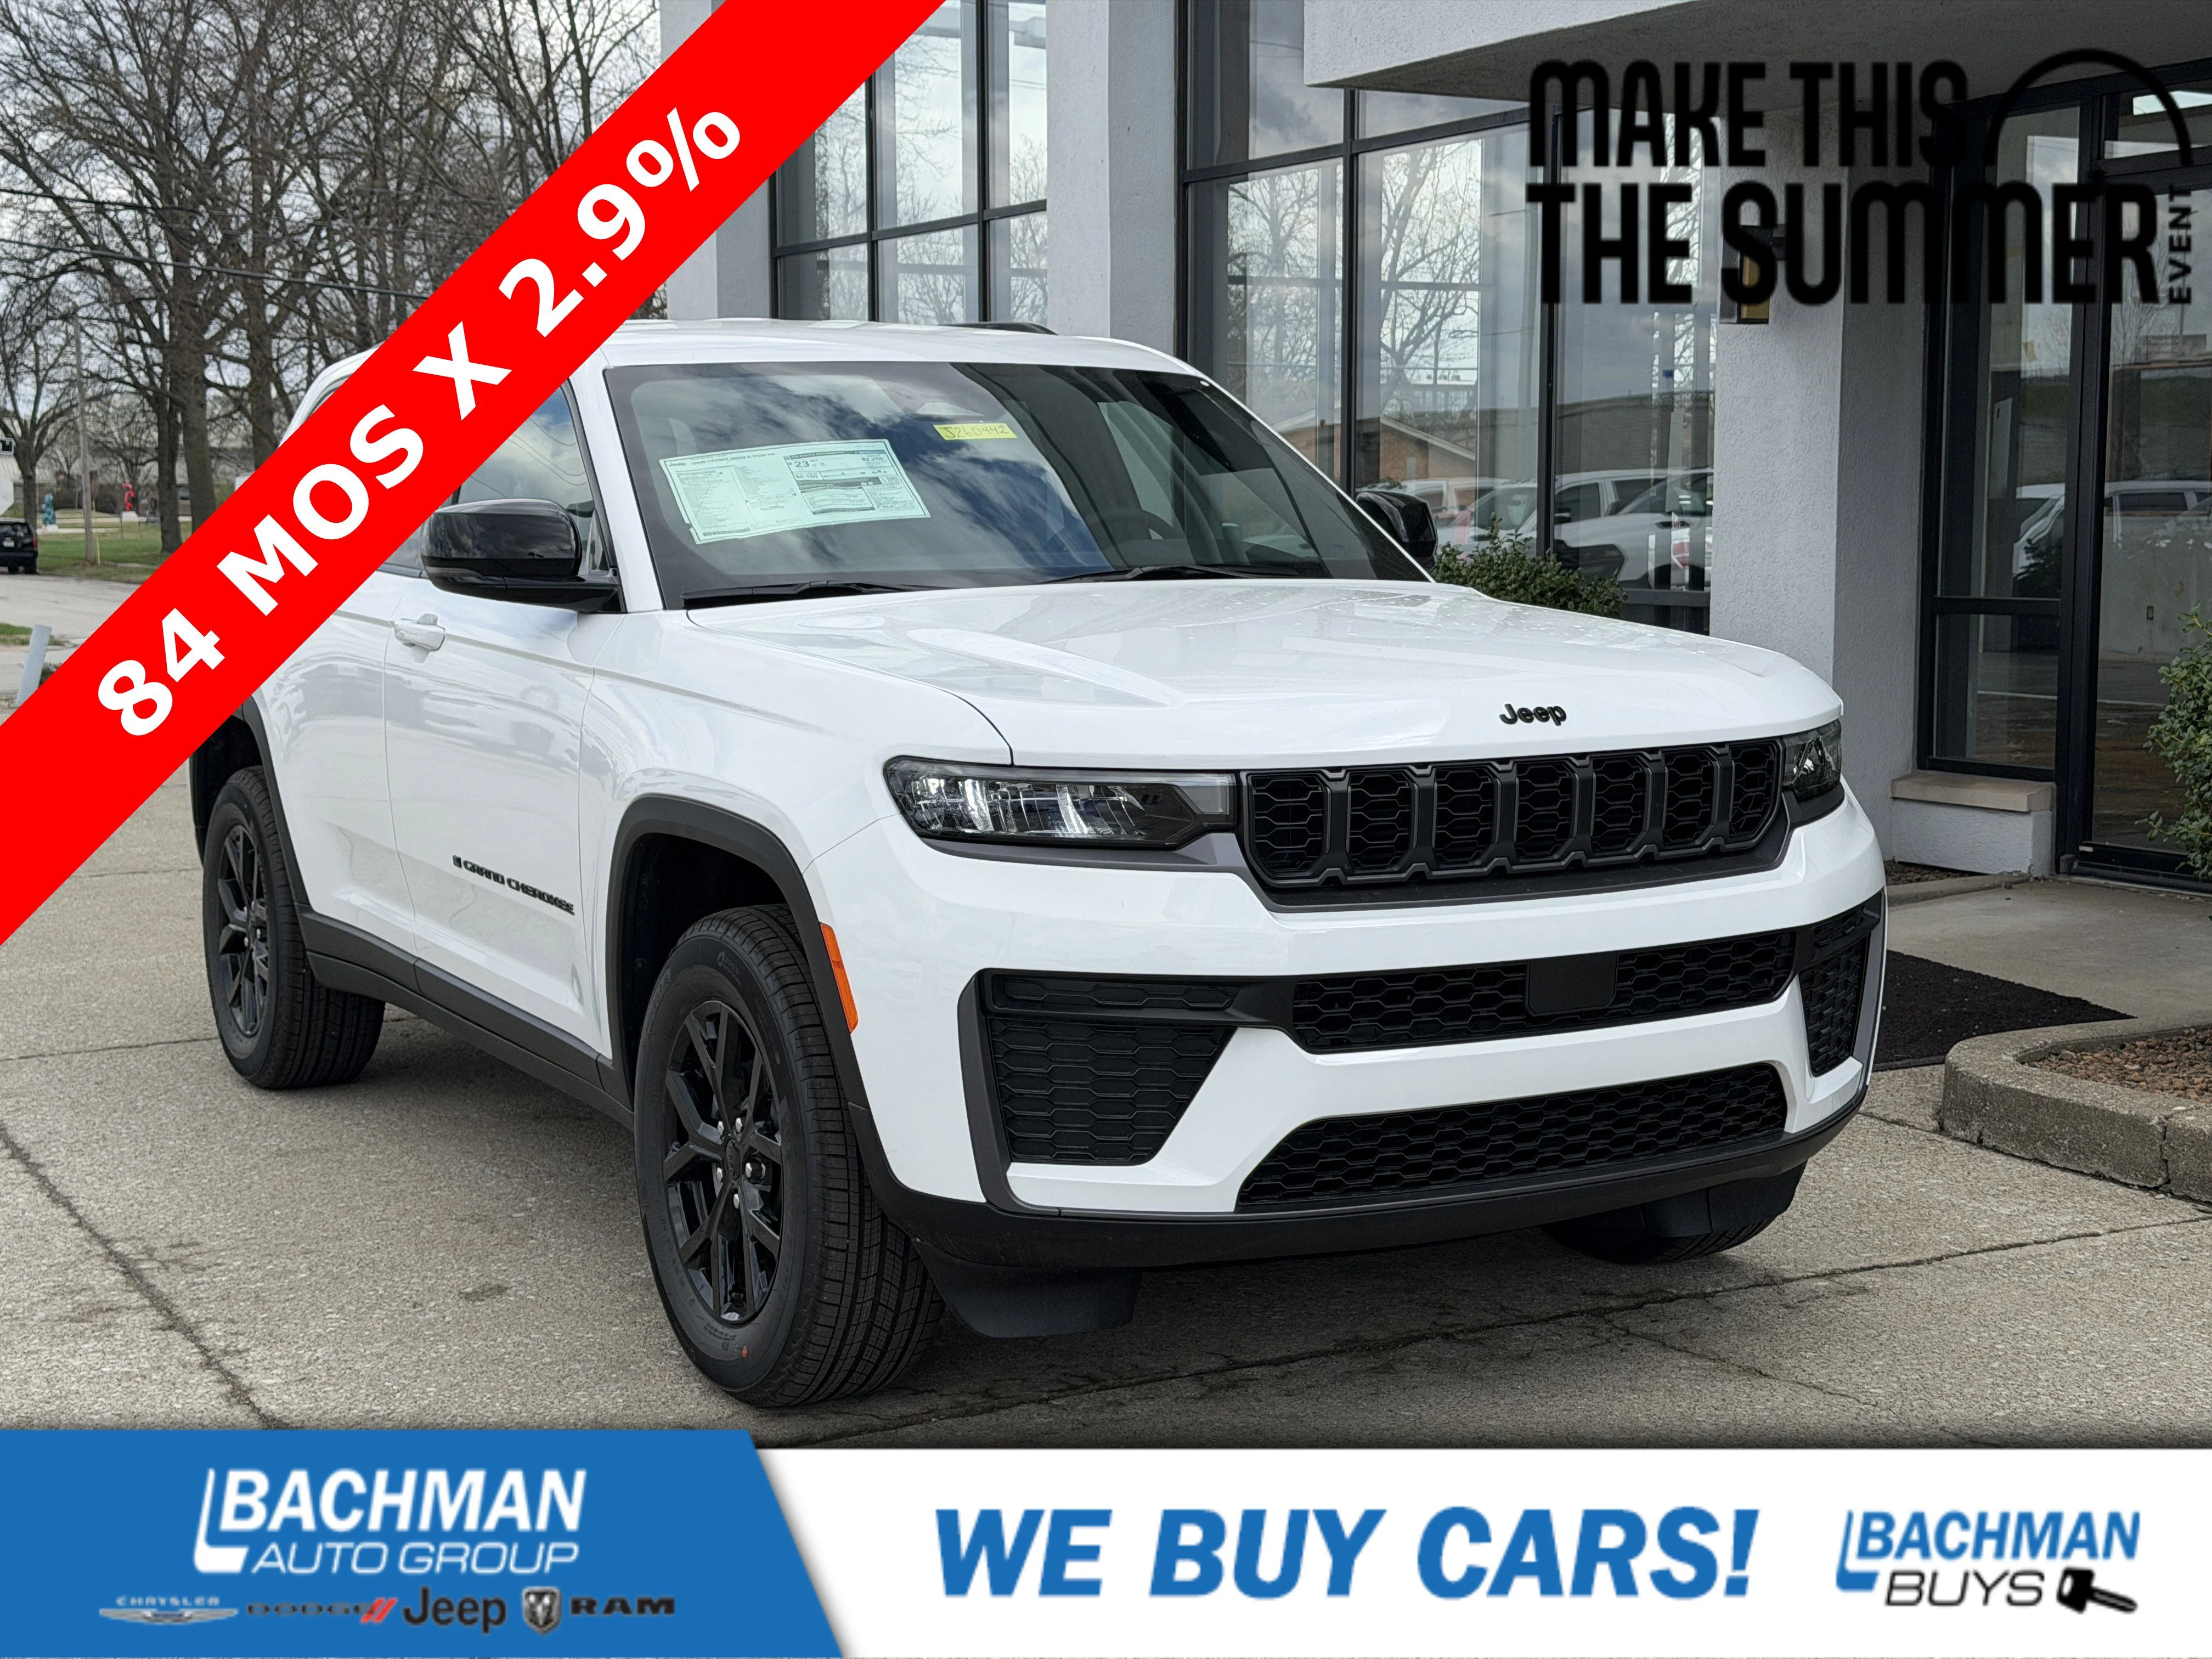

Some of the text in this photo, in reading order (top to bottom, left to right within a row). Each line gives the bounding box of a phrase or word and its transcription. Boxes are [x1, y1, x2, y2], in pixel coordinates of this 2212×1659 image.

[1499, 703, 1567, 726] Jeep
[463, 860, 575, 916] GRAND CHEROKEE
